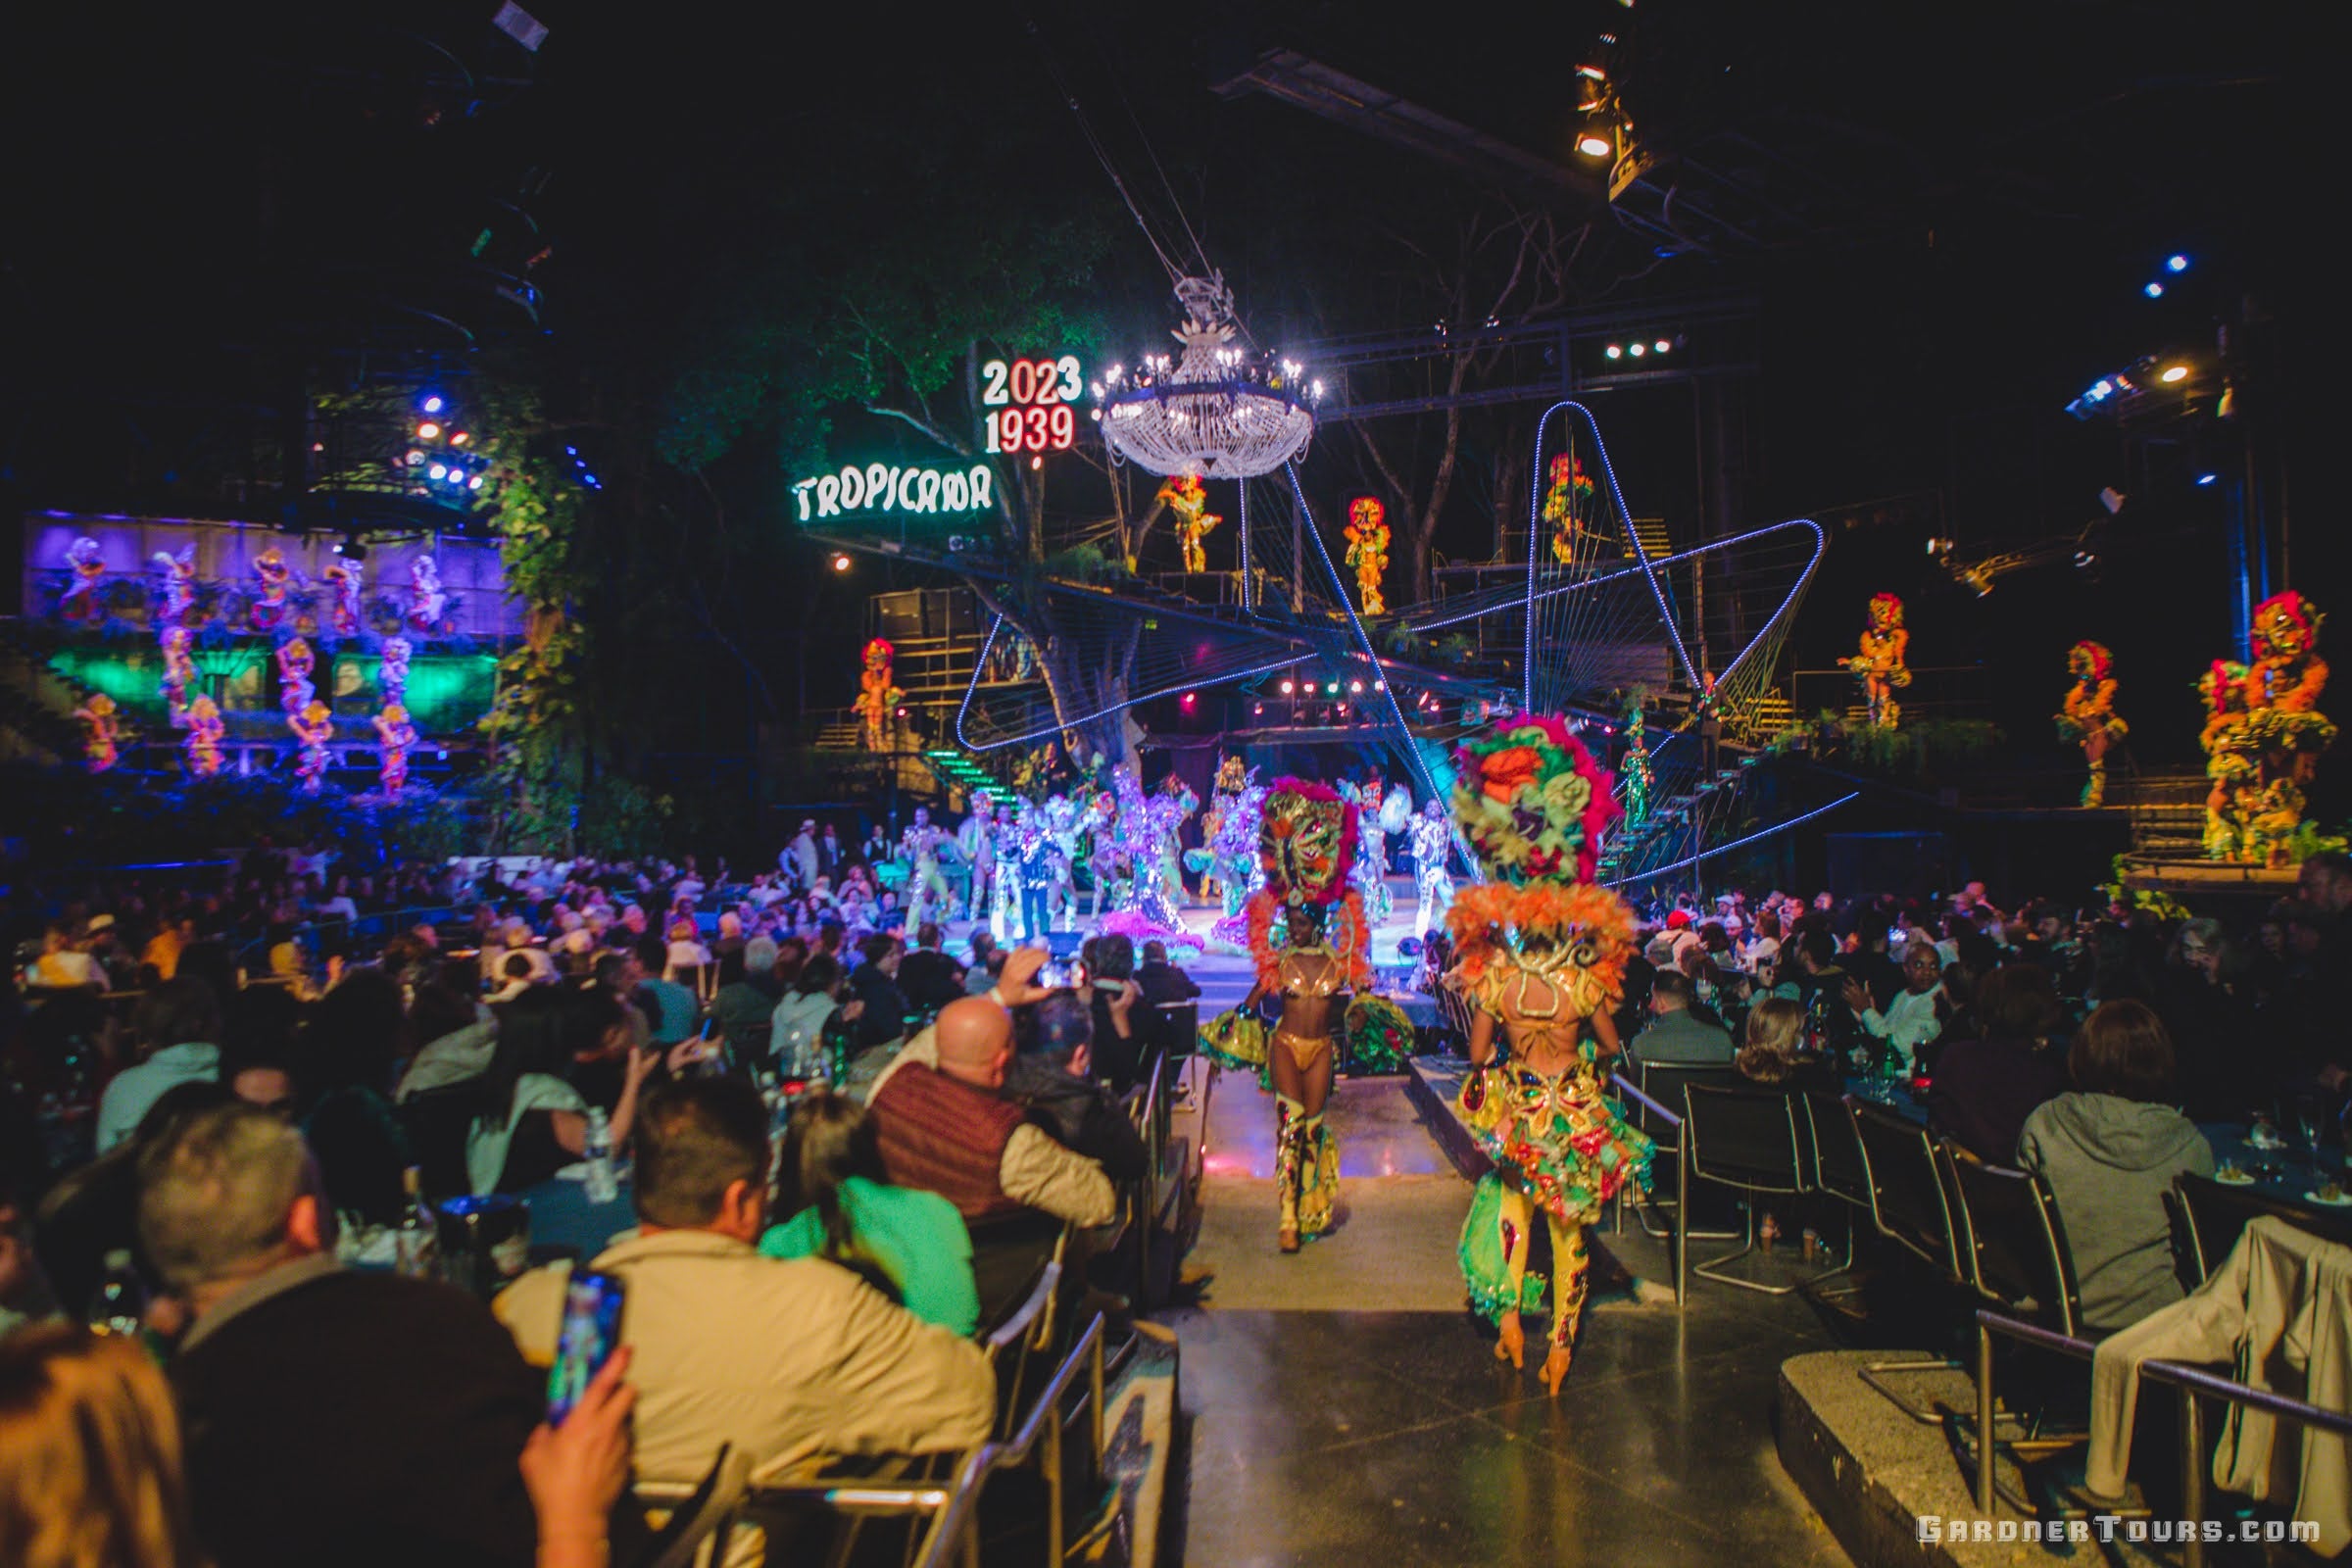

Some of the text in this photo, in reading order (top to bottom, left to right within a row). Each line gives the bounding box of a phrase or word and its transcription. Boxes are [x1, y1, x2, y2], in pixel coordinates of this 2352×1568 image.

[983, 357, 1083, 405] 2023
[985, 407, 1073, 453] 1939
[792, 464, 992, 521] TROPICANA
